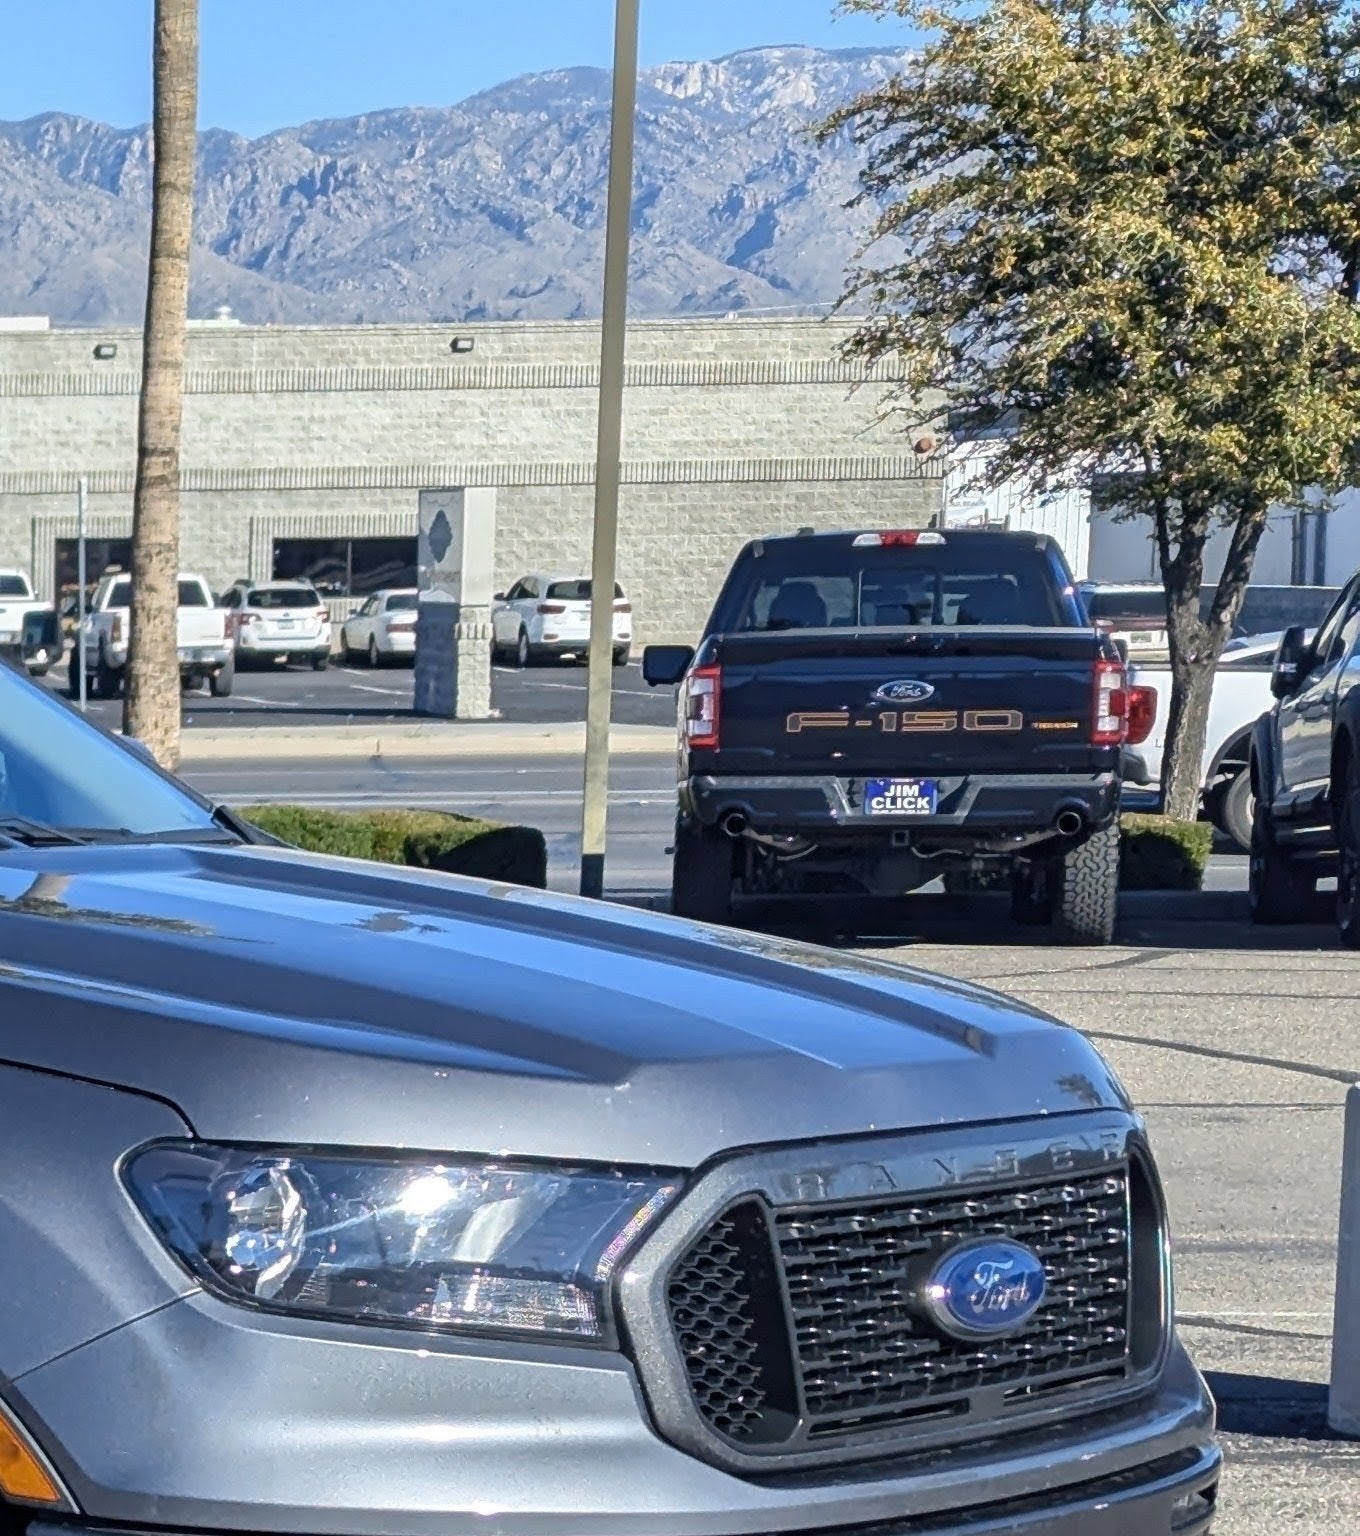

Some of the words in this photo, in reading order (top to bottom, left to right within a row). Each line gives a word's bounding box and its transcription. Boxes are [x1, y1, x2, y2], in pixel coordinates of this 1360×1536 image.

[785, 709, 1024, 733] F-150
[883, 784, 921, 797] JIM
[871, 796, 931, 809] CLICK
[969, 1259, 1031, 1313] Ford
